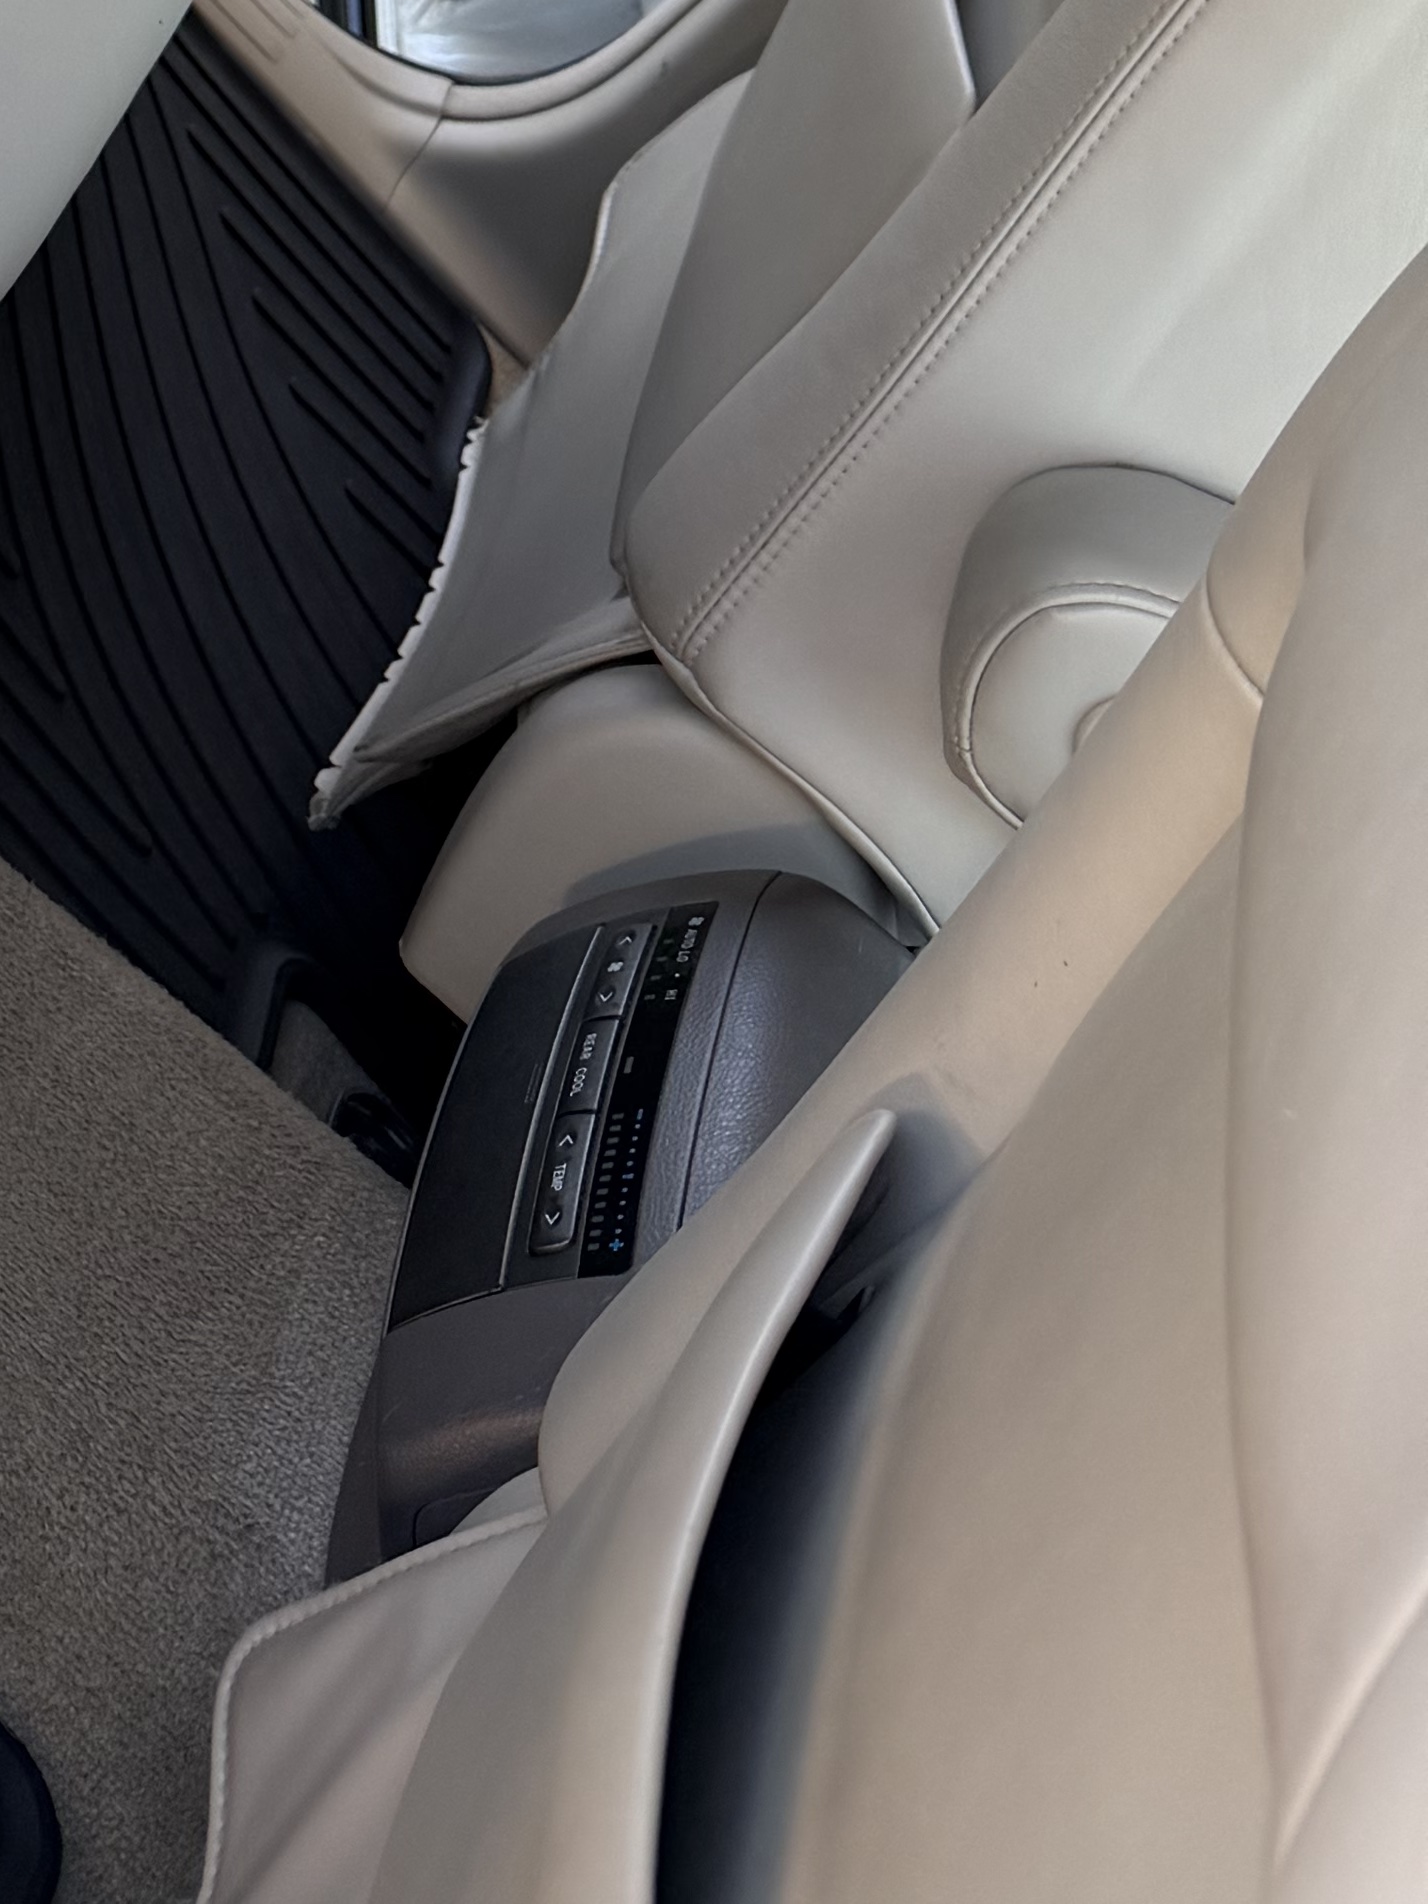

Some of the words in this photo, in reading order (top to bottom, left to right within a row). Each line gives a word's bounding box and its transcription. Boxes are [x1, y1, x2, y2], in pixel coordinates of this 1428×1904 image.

[579, 1033, 597, 1061] REAR
[569, 1067, 587, 1097] COOL
[551, 1162, 567, 1191] TEMP
